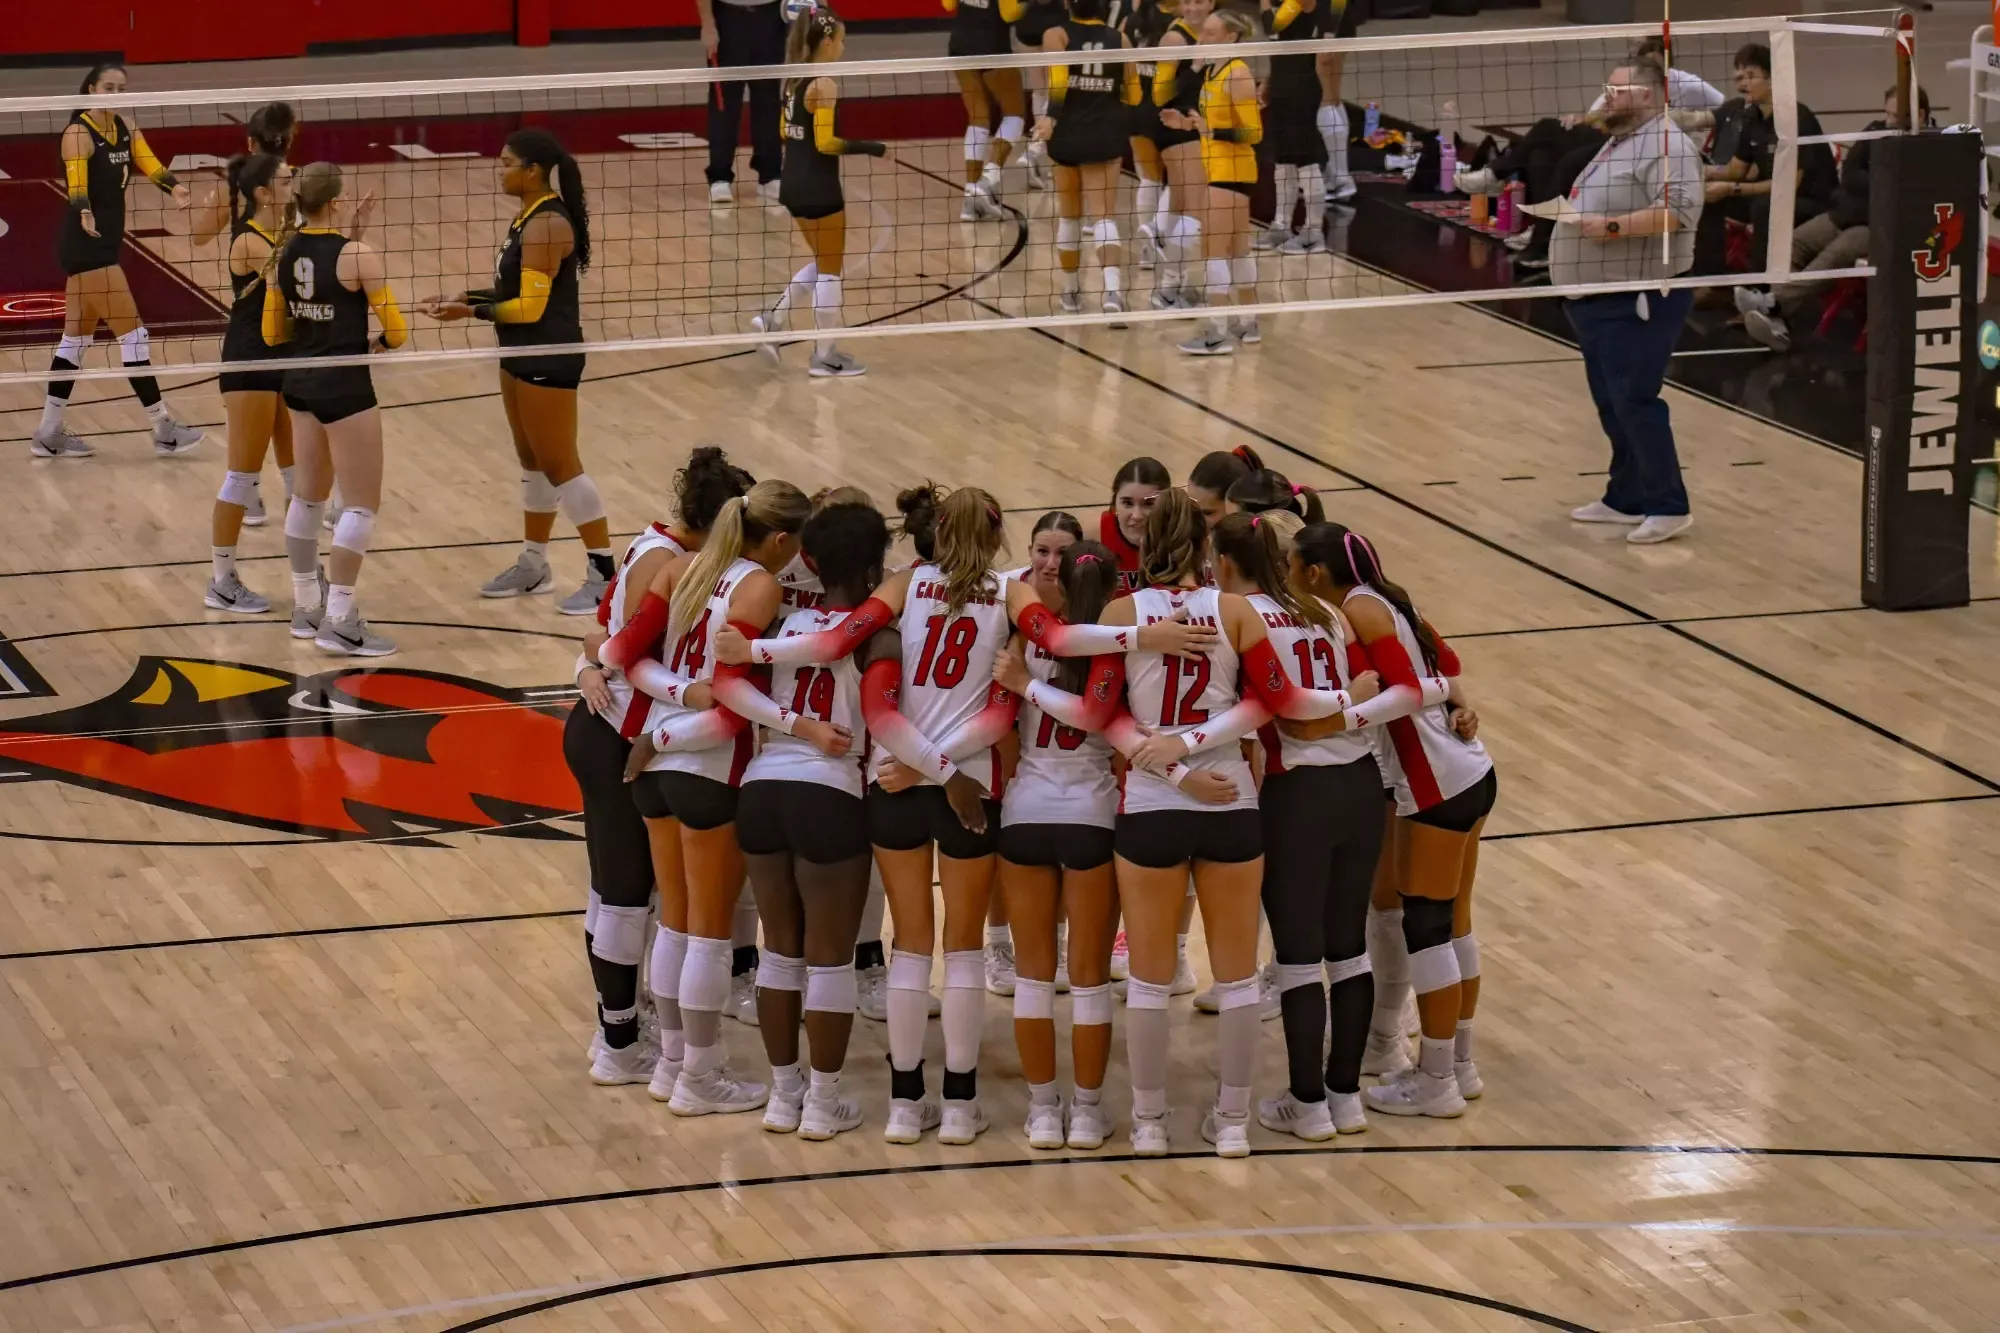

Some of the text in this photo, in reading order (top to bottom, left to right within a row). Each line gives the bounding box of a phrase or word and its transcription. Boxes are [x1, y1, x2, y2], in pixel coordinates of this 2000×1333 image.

[1068, 75, 1115, 92] HAWKS
[294, 257, 314, 300] 9
[1908, 265, 1961, 495] JEWELL
[669, 608, 712, 679] 14
[912, 613, 978, 689] 18
[1292, 638, 1342, 691] 13
[791, 666, 835, 722] 19
[1159, 650, 1211, 726] 12
